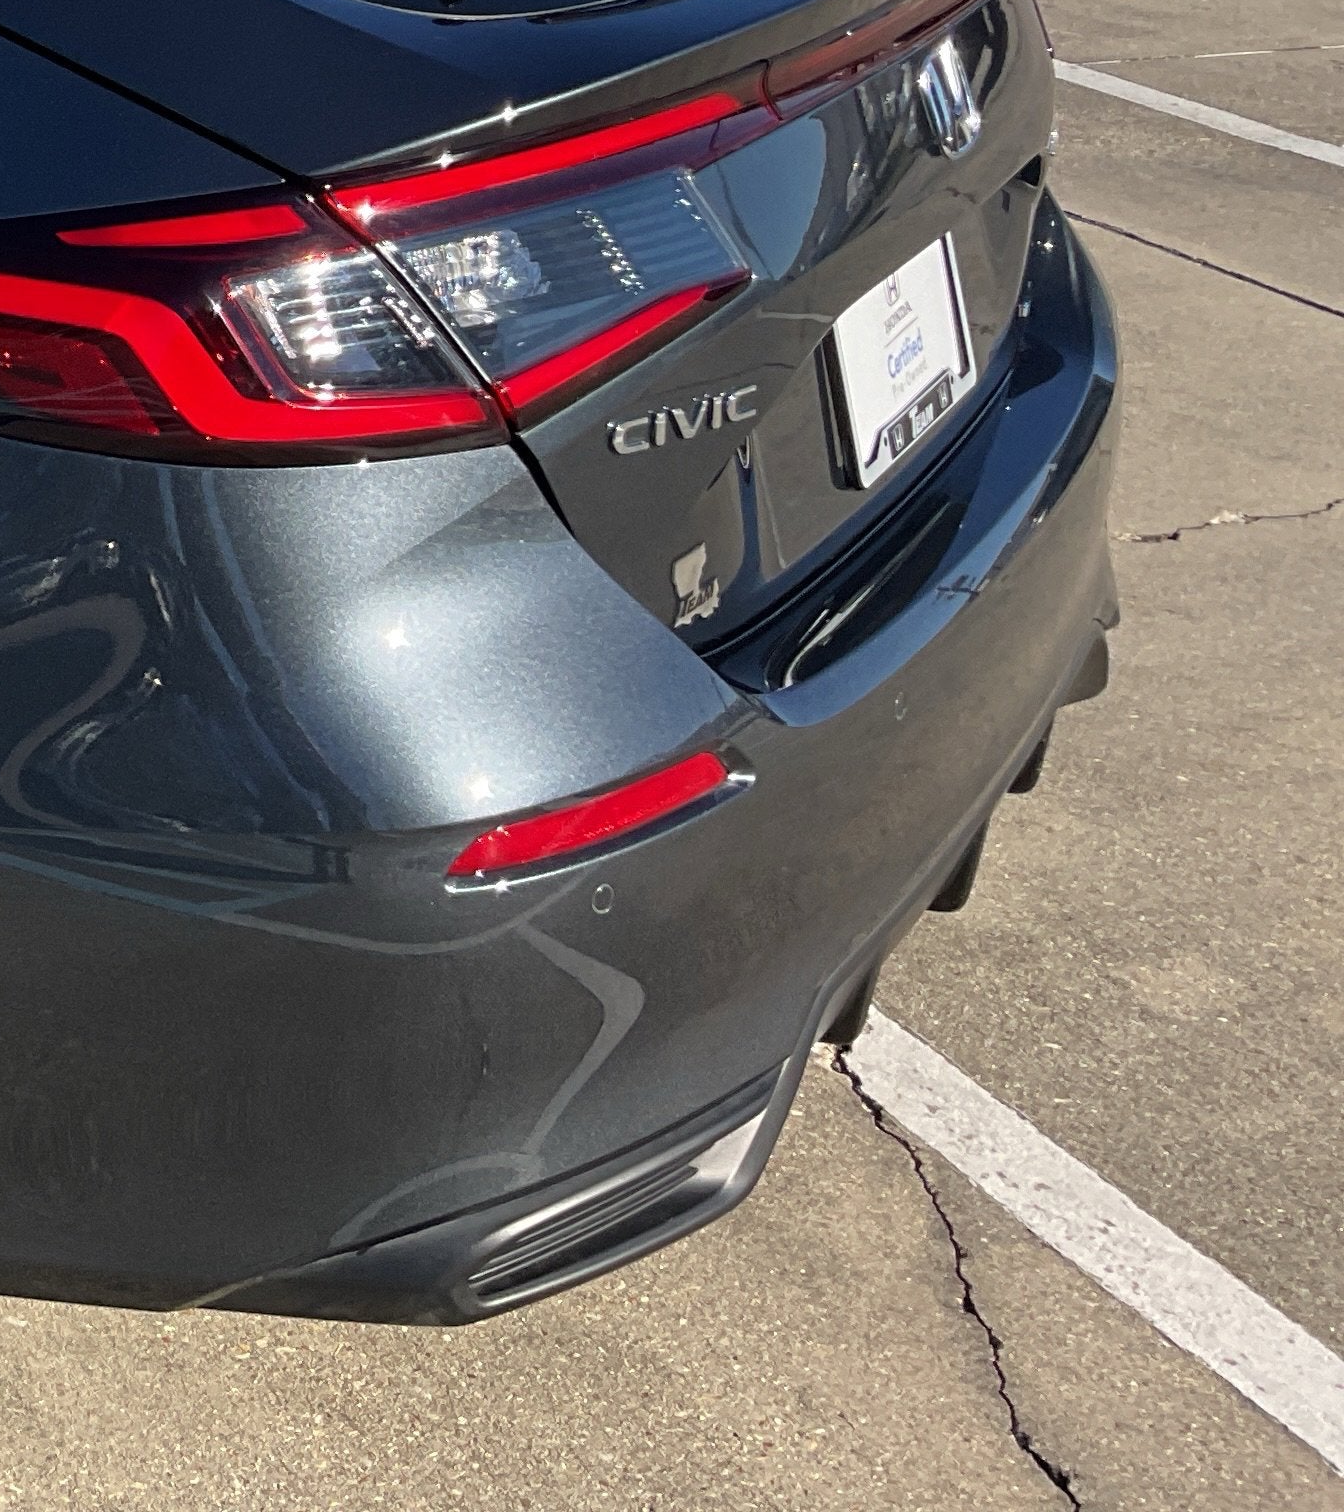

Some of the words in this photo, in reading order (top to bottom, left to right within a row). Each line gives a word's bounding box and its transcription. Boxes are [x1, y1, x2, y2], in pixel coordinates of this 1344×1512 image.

[887, 328, 924, 378] Certified
[610, 384, 758, 455] CIVIC
[909, 403, 935, 439] TEAM
[681, 586, 715, 618] TEAM
